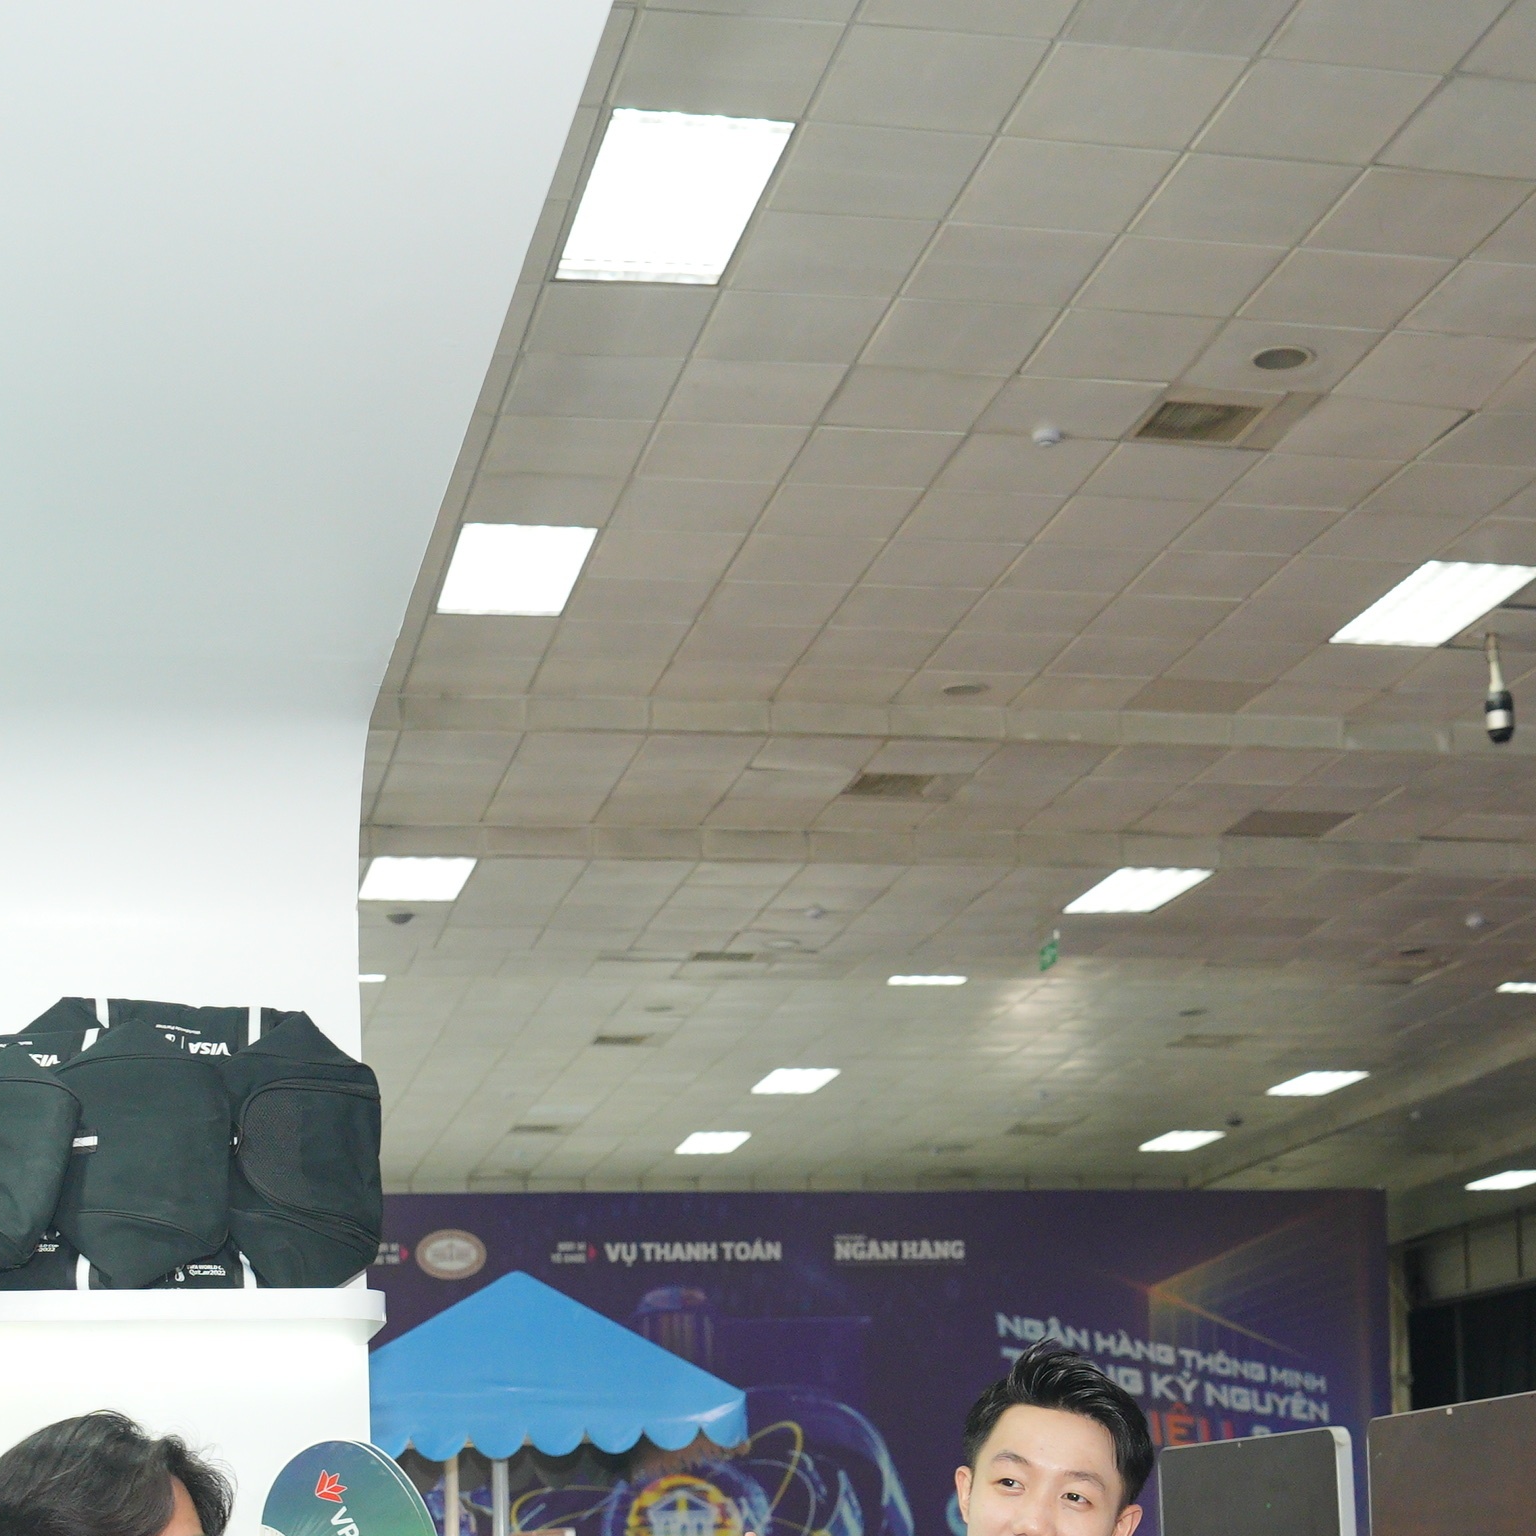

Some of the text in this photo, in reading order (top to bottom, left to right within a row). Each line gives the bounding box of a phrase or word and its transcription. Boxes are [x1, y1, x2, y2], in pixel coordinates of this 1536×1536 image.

[29, 1053, 61, 1067] VIS
[188, 1042, 231, 1056] VISA
[604, 1242, 638, 1267] VỤ
[641, 1242, 718, 1262] THANH
[720, 1237, 782, 1262] TOÁN
[996, 1312, 1327, 1394] NGÂN HÀNG THÔNG MINH
[1205, 1381, 1331, 1423] NGUYÊN
